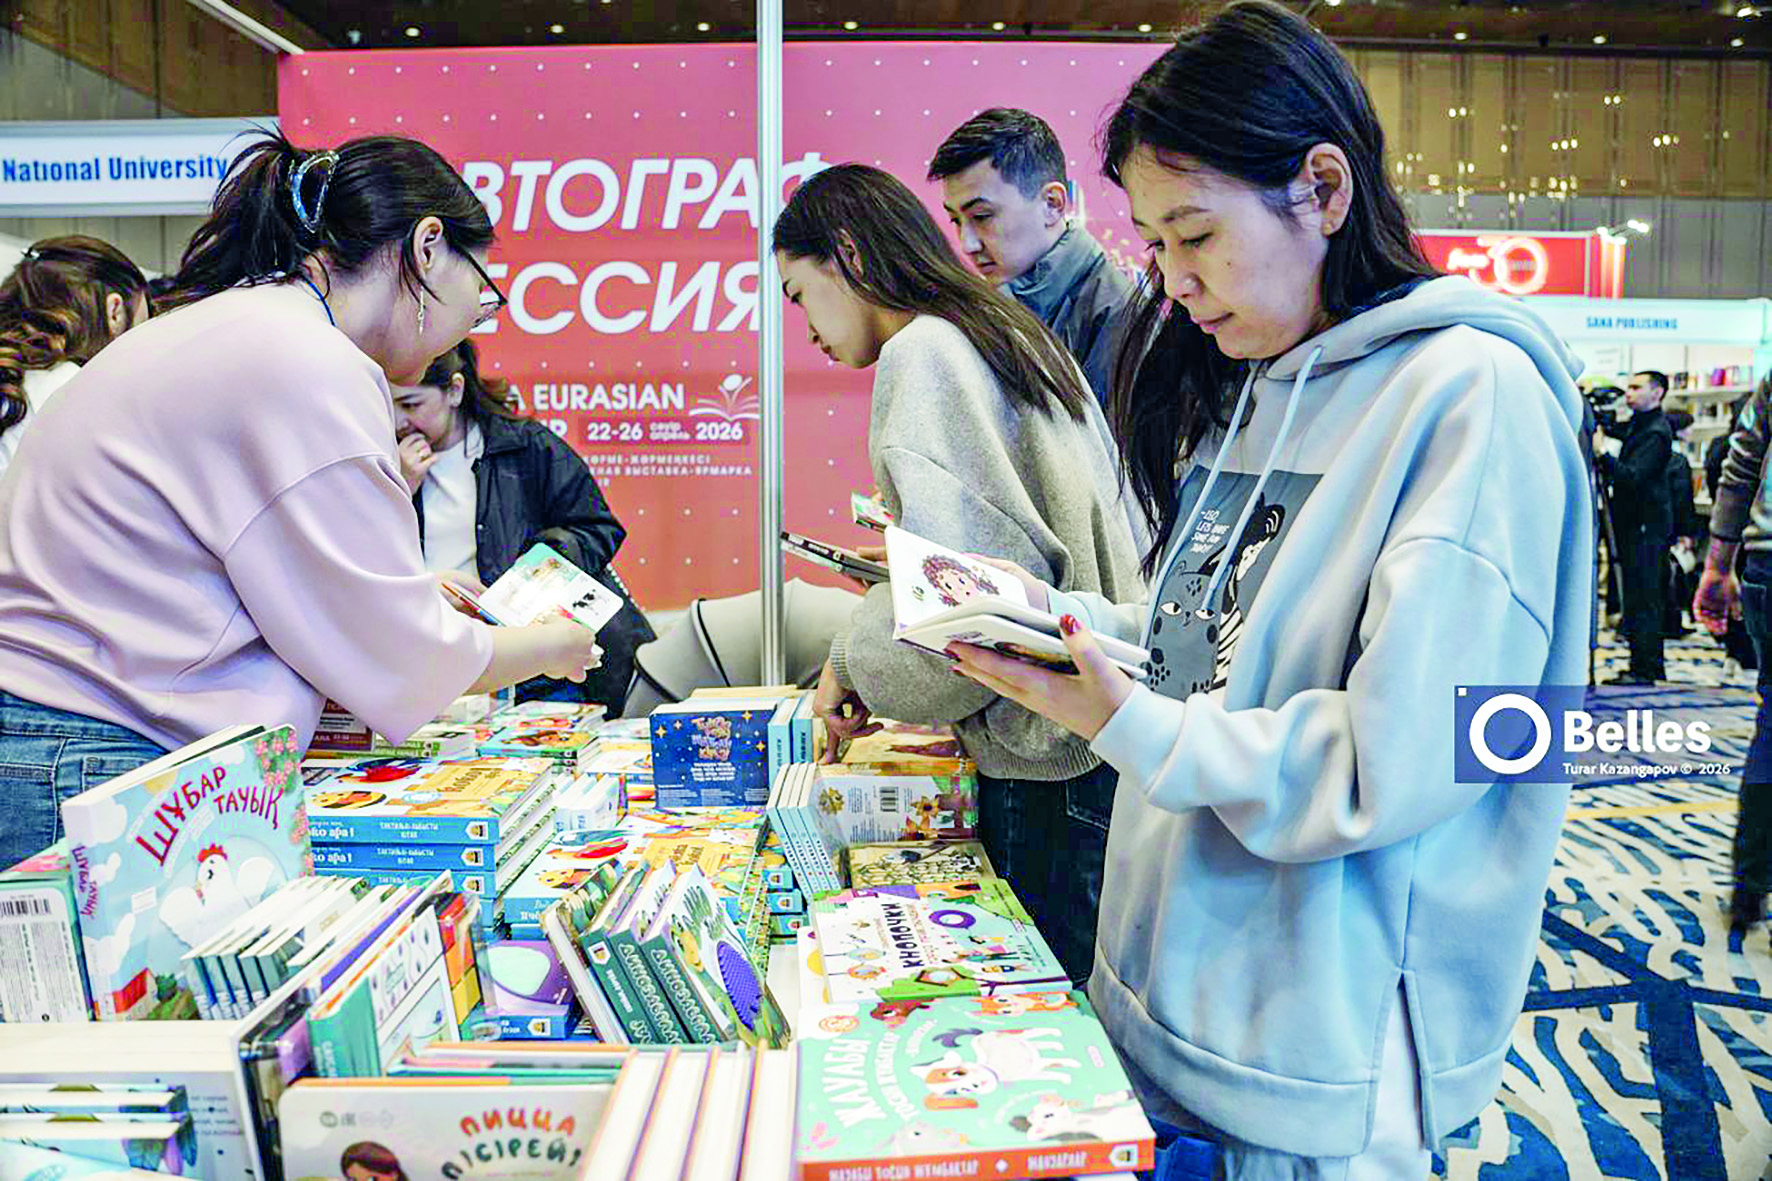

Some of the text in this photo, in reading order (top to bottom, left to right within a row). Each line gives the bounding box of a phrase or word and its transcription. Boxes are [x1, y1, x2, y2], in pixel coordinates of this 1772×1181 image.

[3, 154, 228, 183] National University
[1615, 316, 1678, 329] PUBLISHING
[533, 383, 685, 411] EURASIAN
[587, 422, 643, 441] 22-26
[696, 422, 743, 441] 2026
[136, 766, 284, 866] ШҰБАР ТАУЫҚ
[881, 903, 925, 969] КНОПОЧКИ
[650, 949, 716, 1045] ДИНОЗАВРЛА
[821, 1038, 887, 1127] ЖАУАБЫ
[459, 1106, 576, 1137] ПИЦЦА
